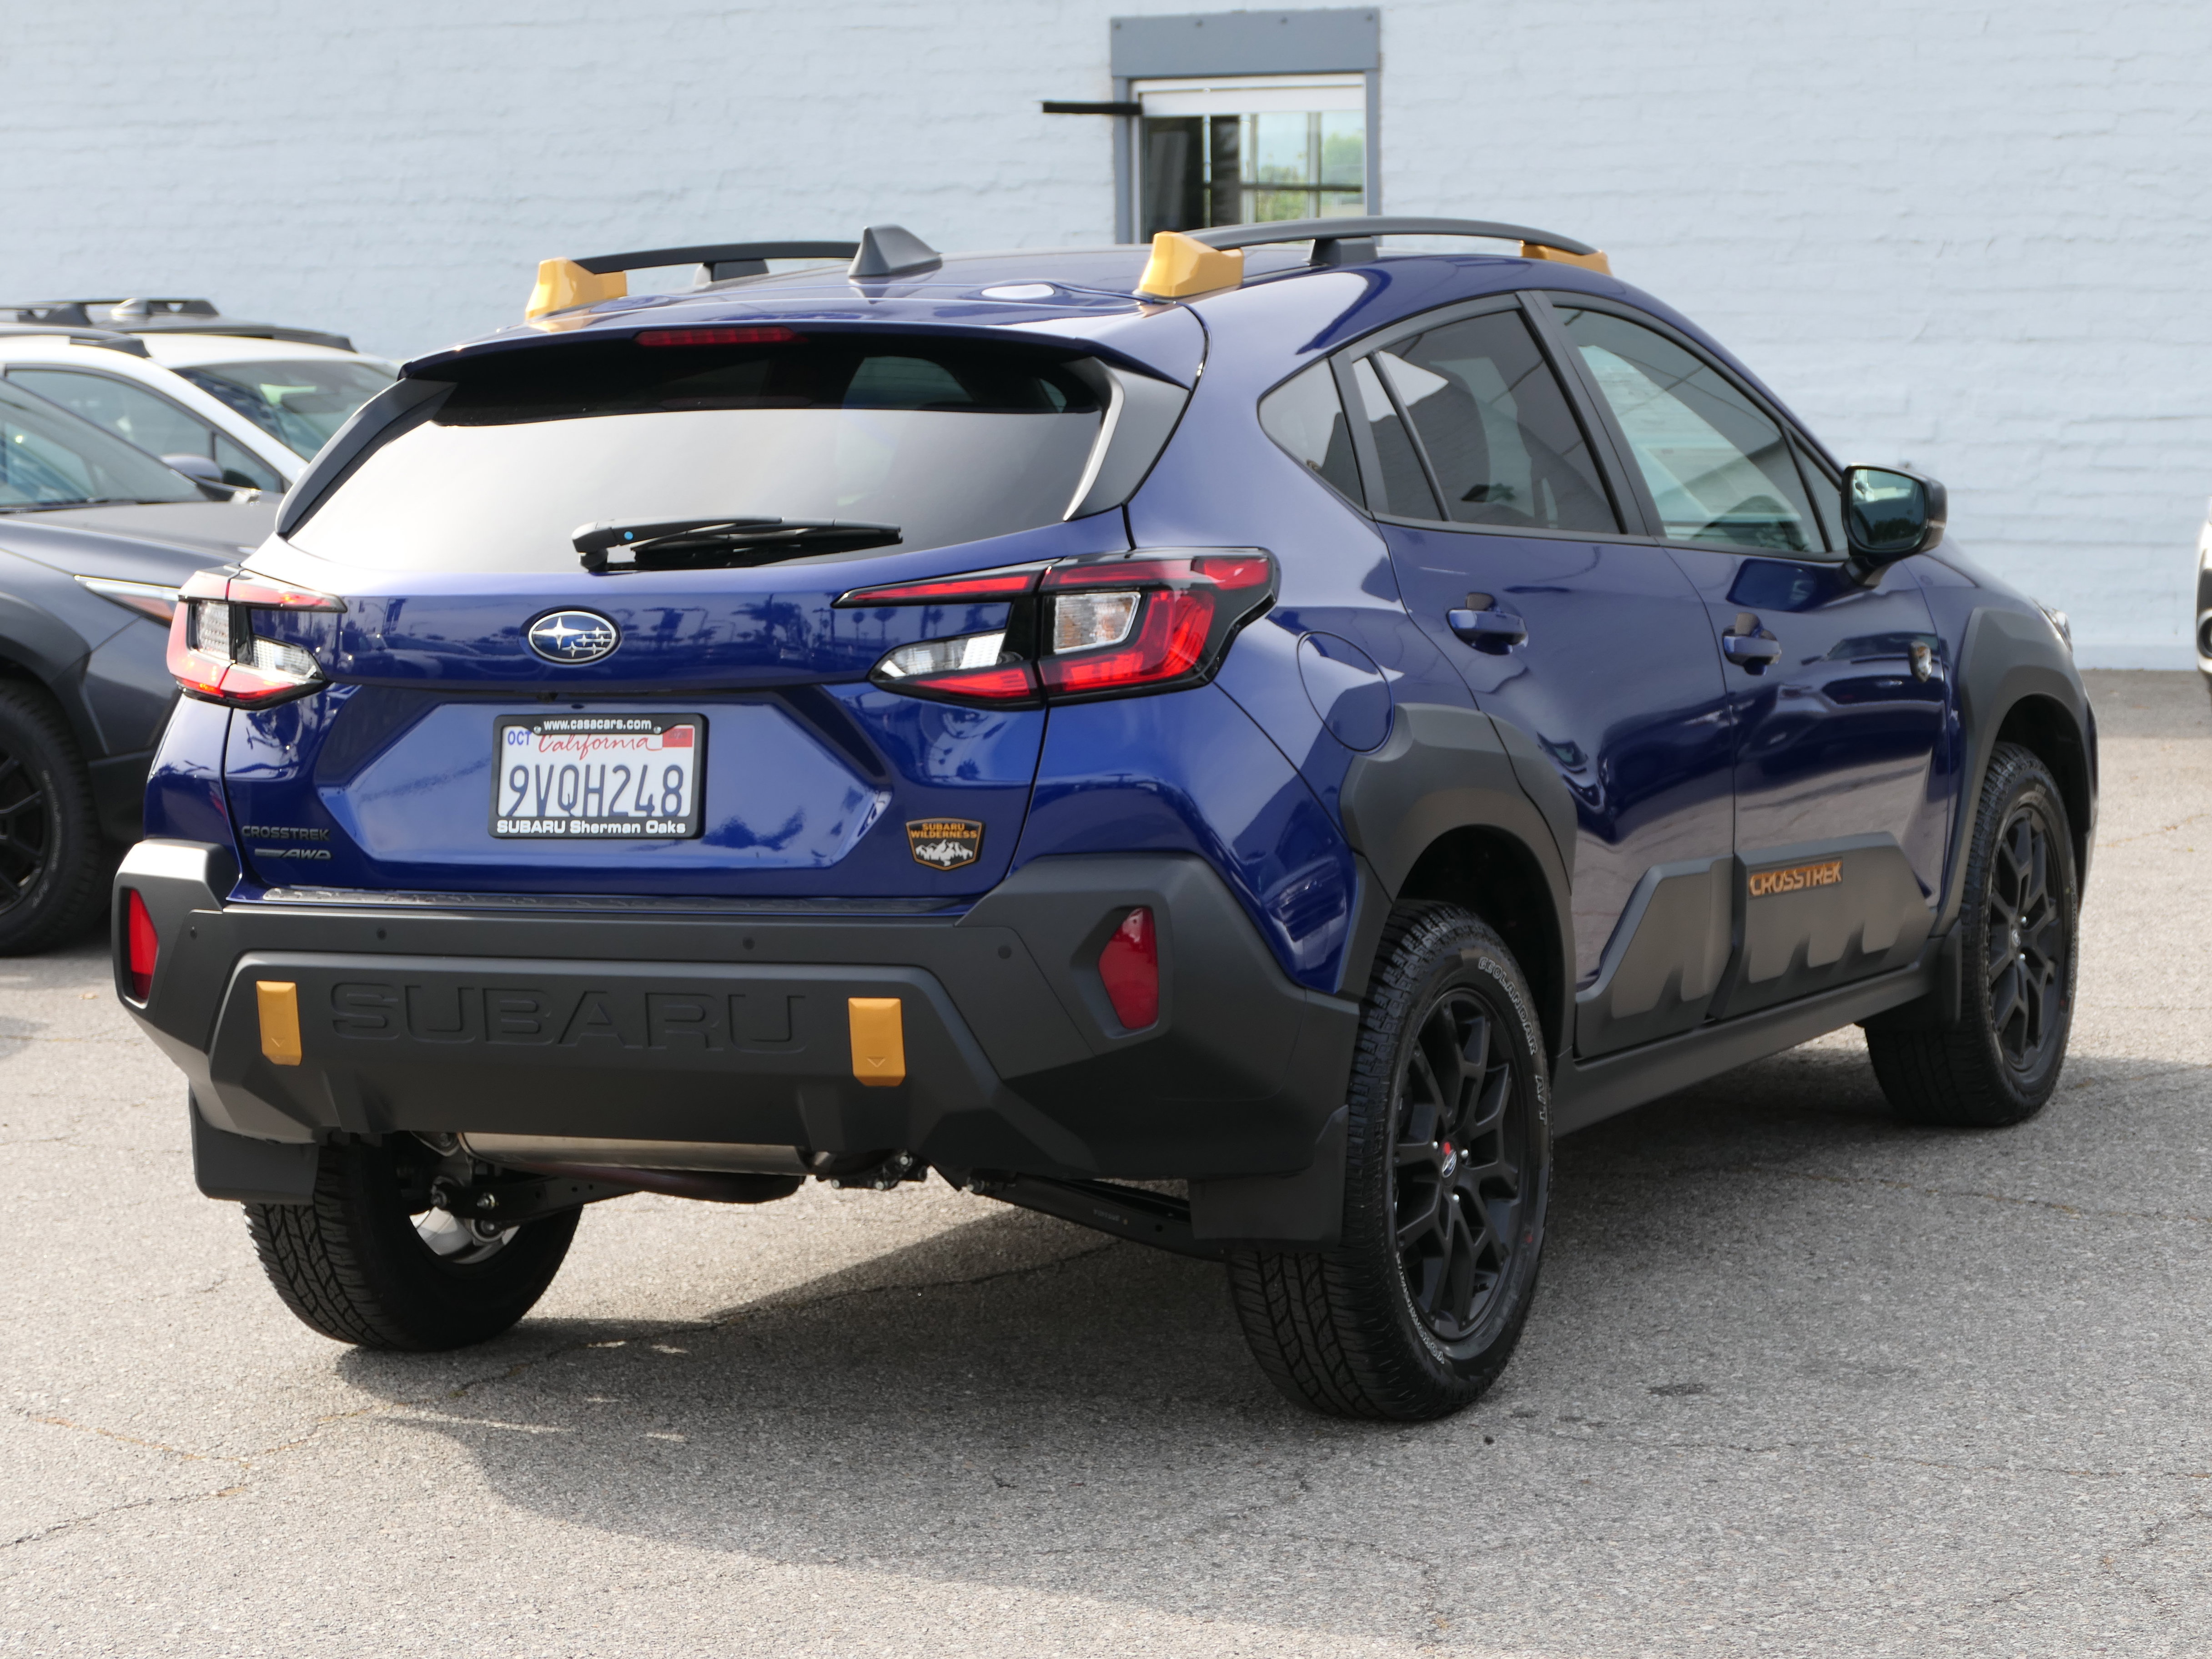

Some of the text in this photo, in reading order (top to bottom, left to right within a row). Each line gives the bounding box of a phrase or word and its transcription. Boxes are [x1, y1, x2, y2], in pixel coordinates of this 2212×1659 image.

[544, 719, 652, 730] www.casacars.com
[508, 730, 532, 746] OCT
[538, 734, 663, 760] California
[506, 764, 684, 818] 9VQH248
[241, 825, 330, 840] CROSSTREK
[497, 819, 686, 834] SUBARU Sherman Oaks
[910, 830, 977, 839] WILDERNESS
[282, 849, 332, 860] AWD
[1749, 861, 1842, 896] CROSSTREK
[1478, 956, 1538, 1056] GEOLANDAR
[329, 982, 809, 1054] SUBARU
[1535, 1075, 1547, 1126] A/T
